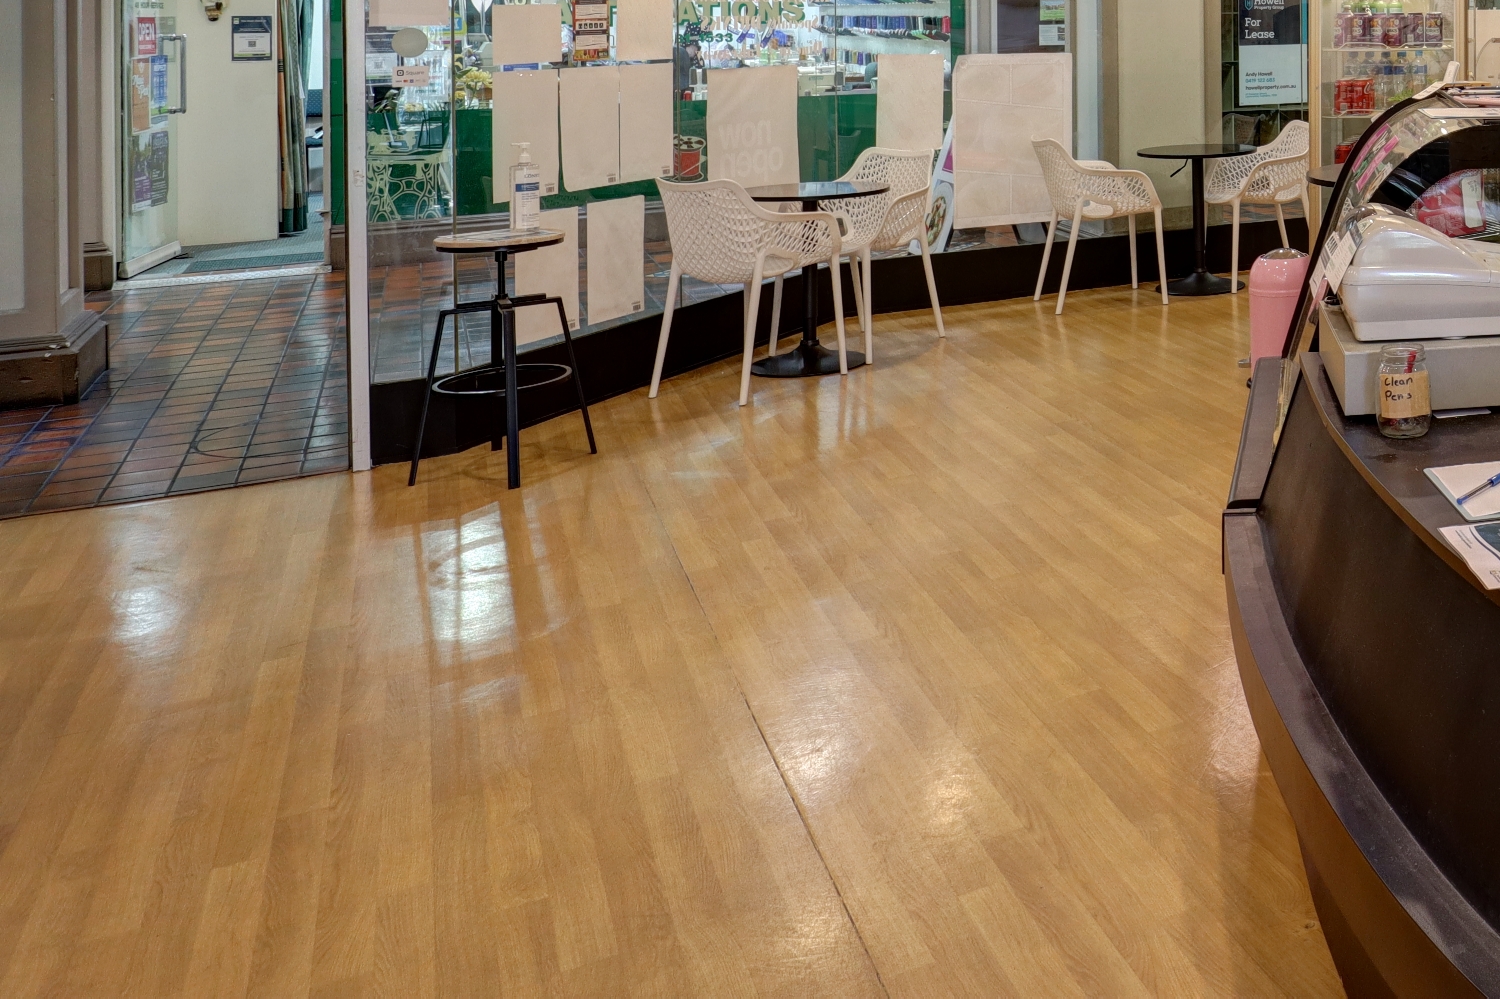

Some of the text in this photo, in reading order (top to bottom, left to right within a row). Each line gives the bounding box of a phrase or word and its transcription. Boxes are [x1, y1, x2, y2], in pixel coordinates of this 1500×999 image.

[1245, 18, 1261, 27] For
[1245, 30, 1275, 39] Lease
[405, 69, 425, 77] Square
[1384, 376, 1413, 387] Clean
[1385, 390, 1412, 401] Pens
